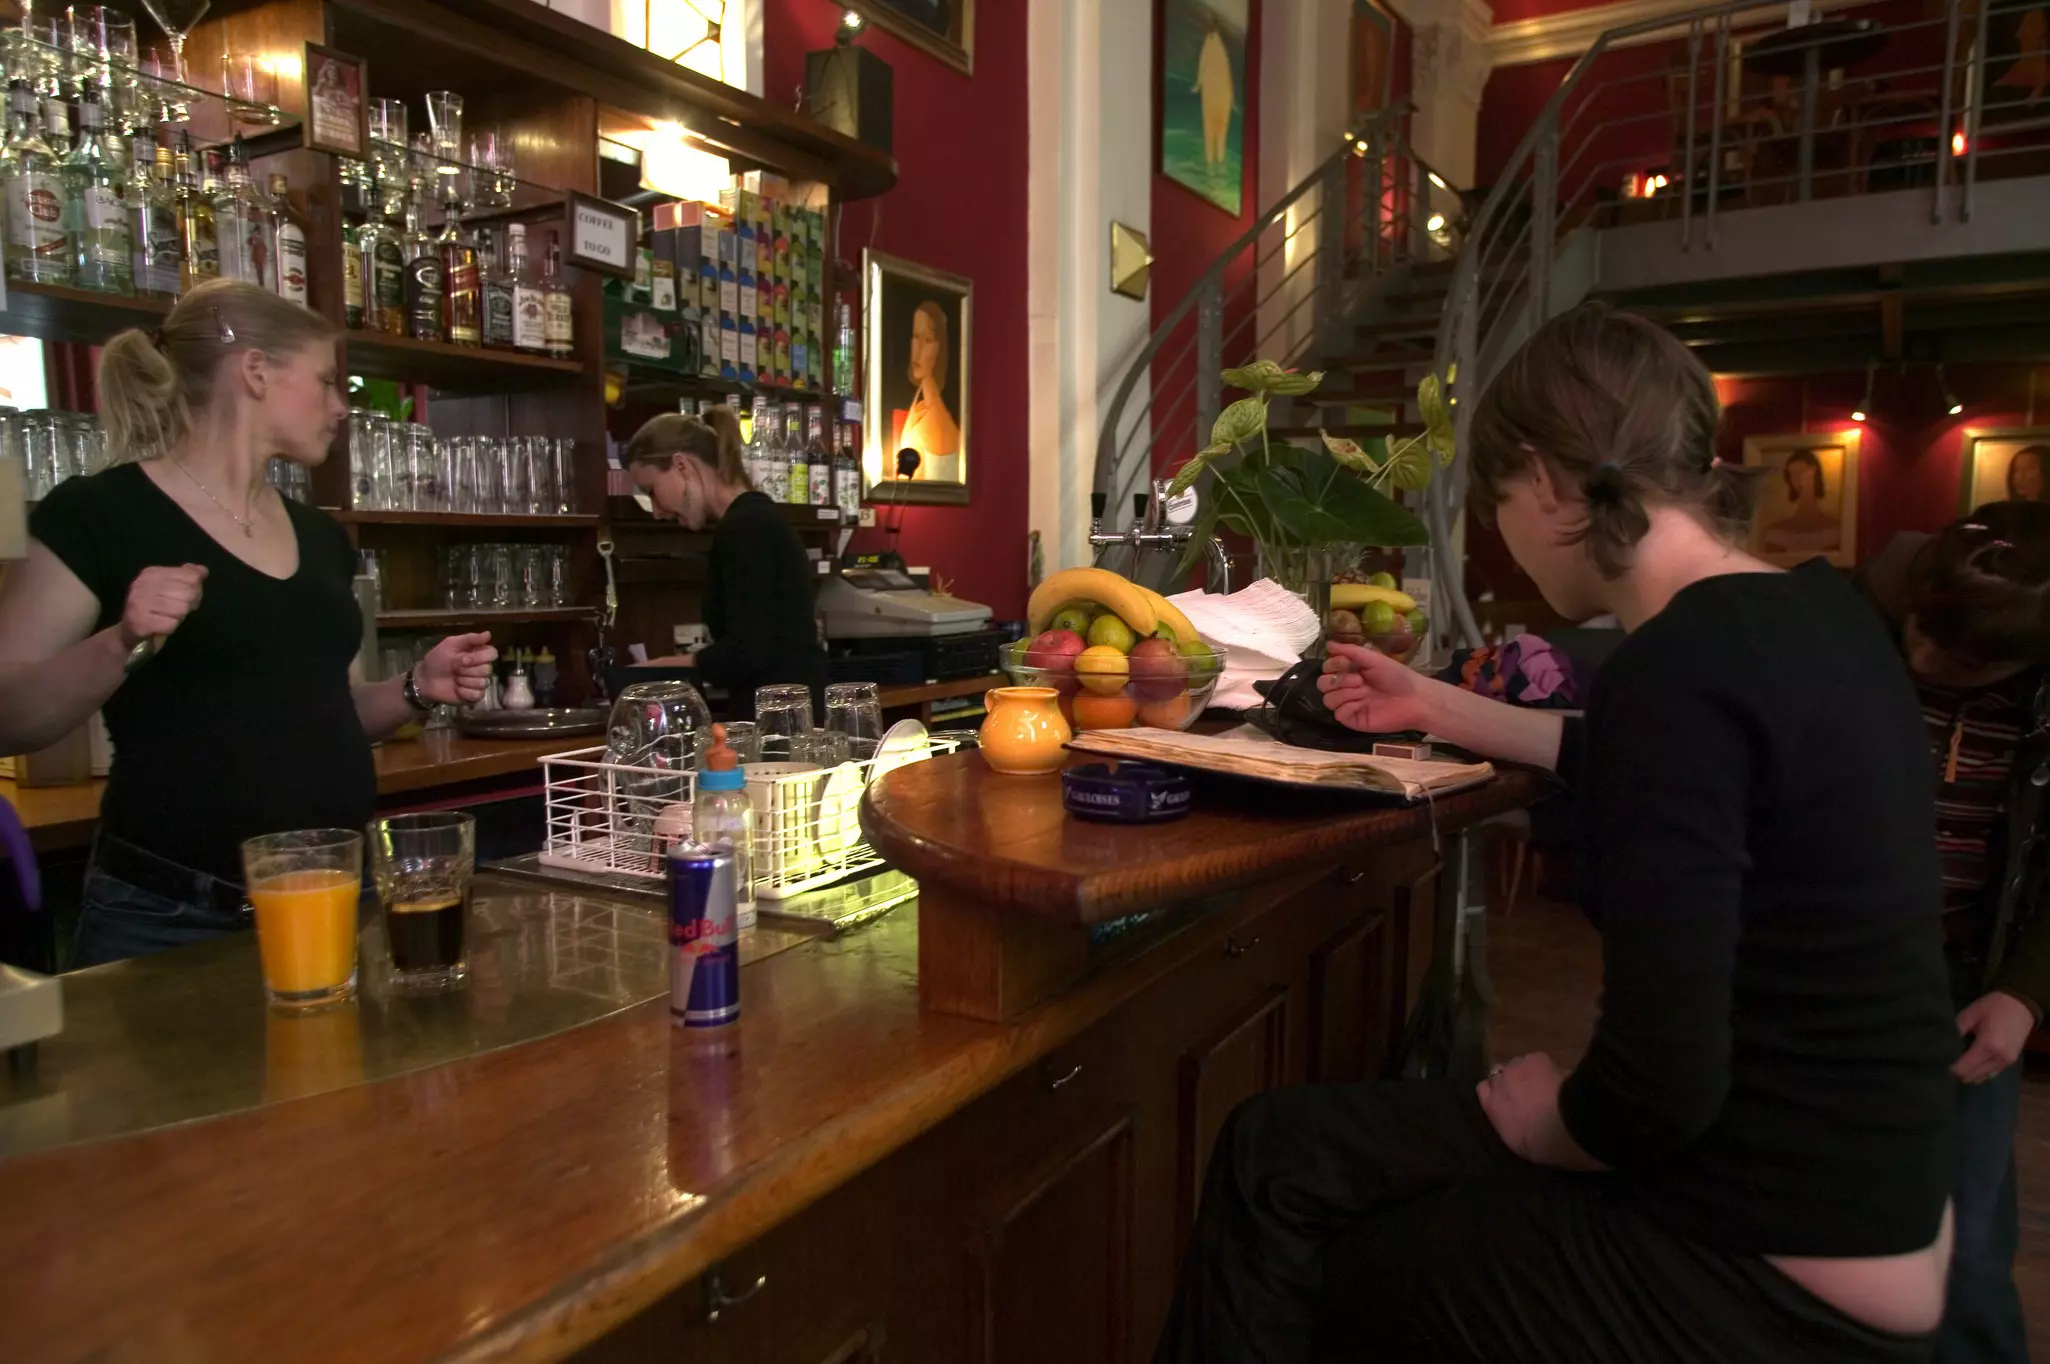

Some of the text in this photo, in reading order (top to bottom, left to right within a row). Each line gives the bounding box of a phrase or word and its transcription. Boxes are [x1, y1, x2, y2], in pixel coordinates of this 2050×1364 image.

[578, 211, 614, 231] COFFEE
[583, 239, 611, 256] TO GO
[1070, 790, 1120, 806] GAULOISES
